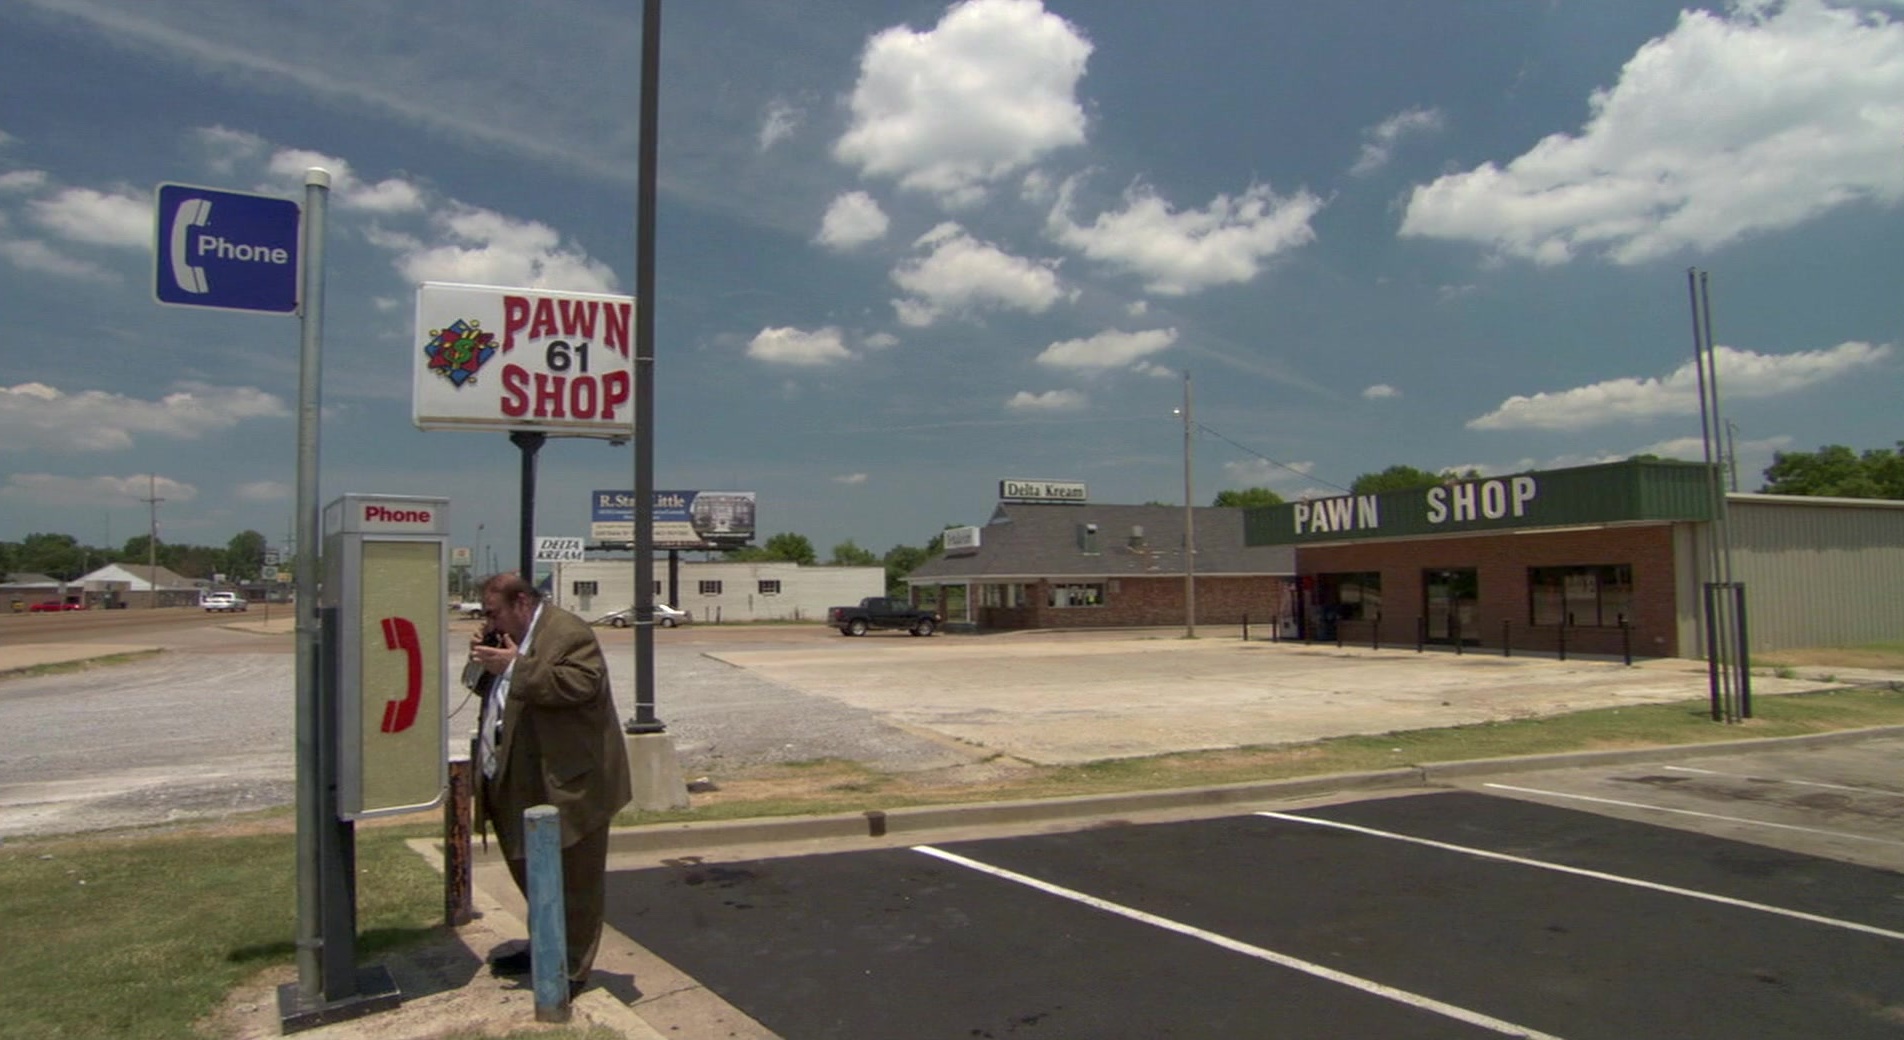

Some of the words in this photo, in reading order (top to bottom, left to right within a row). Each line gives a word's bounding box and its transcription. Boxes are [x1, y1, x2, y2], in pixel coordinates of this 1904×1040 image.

[198, 235, 288, 264] Phone
[502, 295, 632, 359] PAWN
[546, 340, 589, 372] 61
[501, 363, 630, 420] SHOP
[1008, 483, 1040, 496] Delta
[1045, 485, 1083, 497] Kream
[365, 505, 432, 523] Phone
[1294, 495, 1379, 534] PAWN
[1426, 476, 1537, 523] SHOP
[538, 550, 582, 560] KREAM
[541, 540, 579, 549] DELTA
